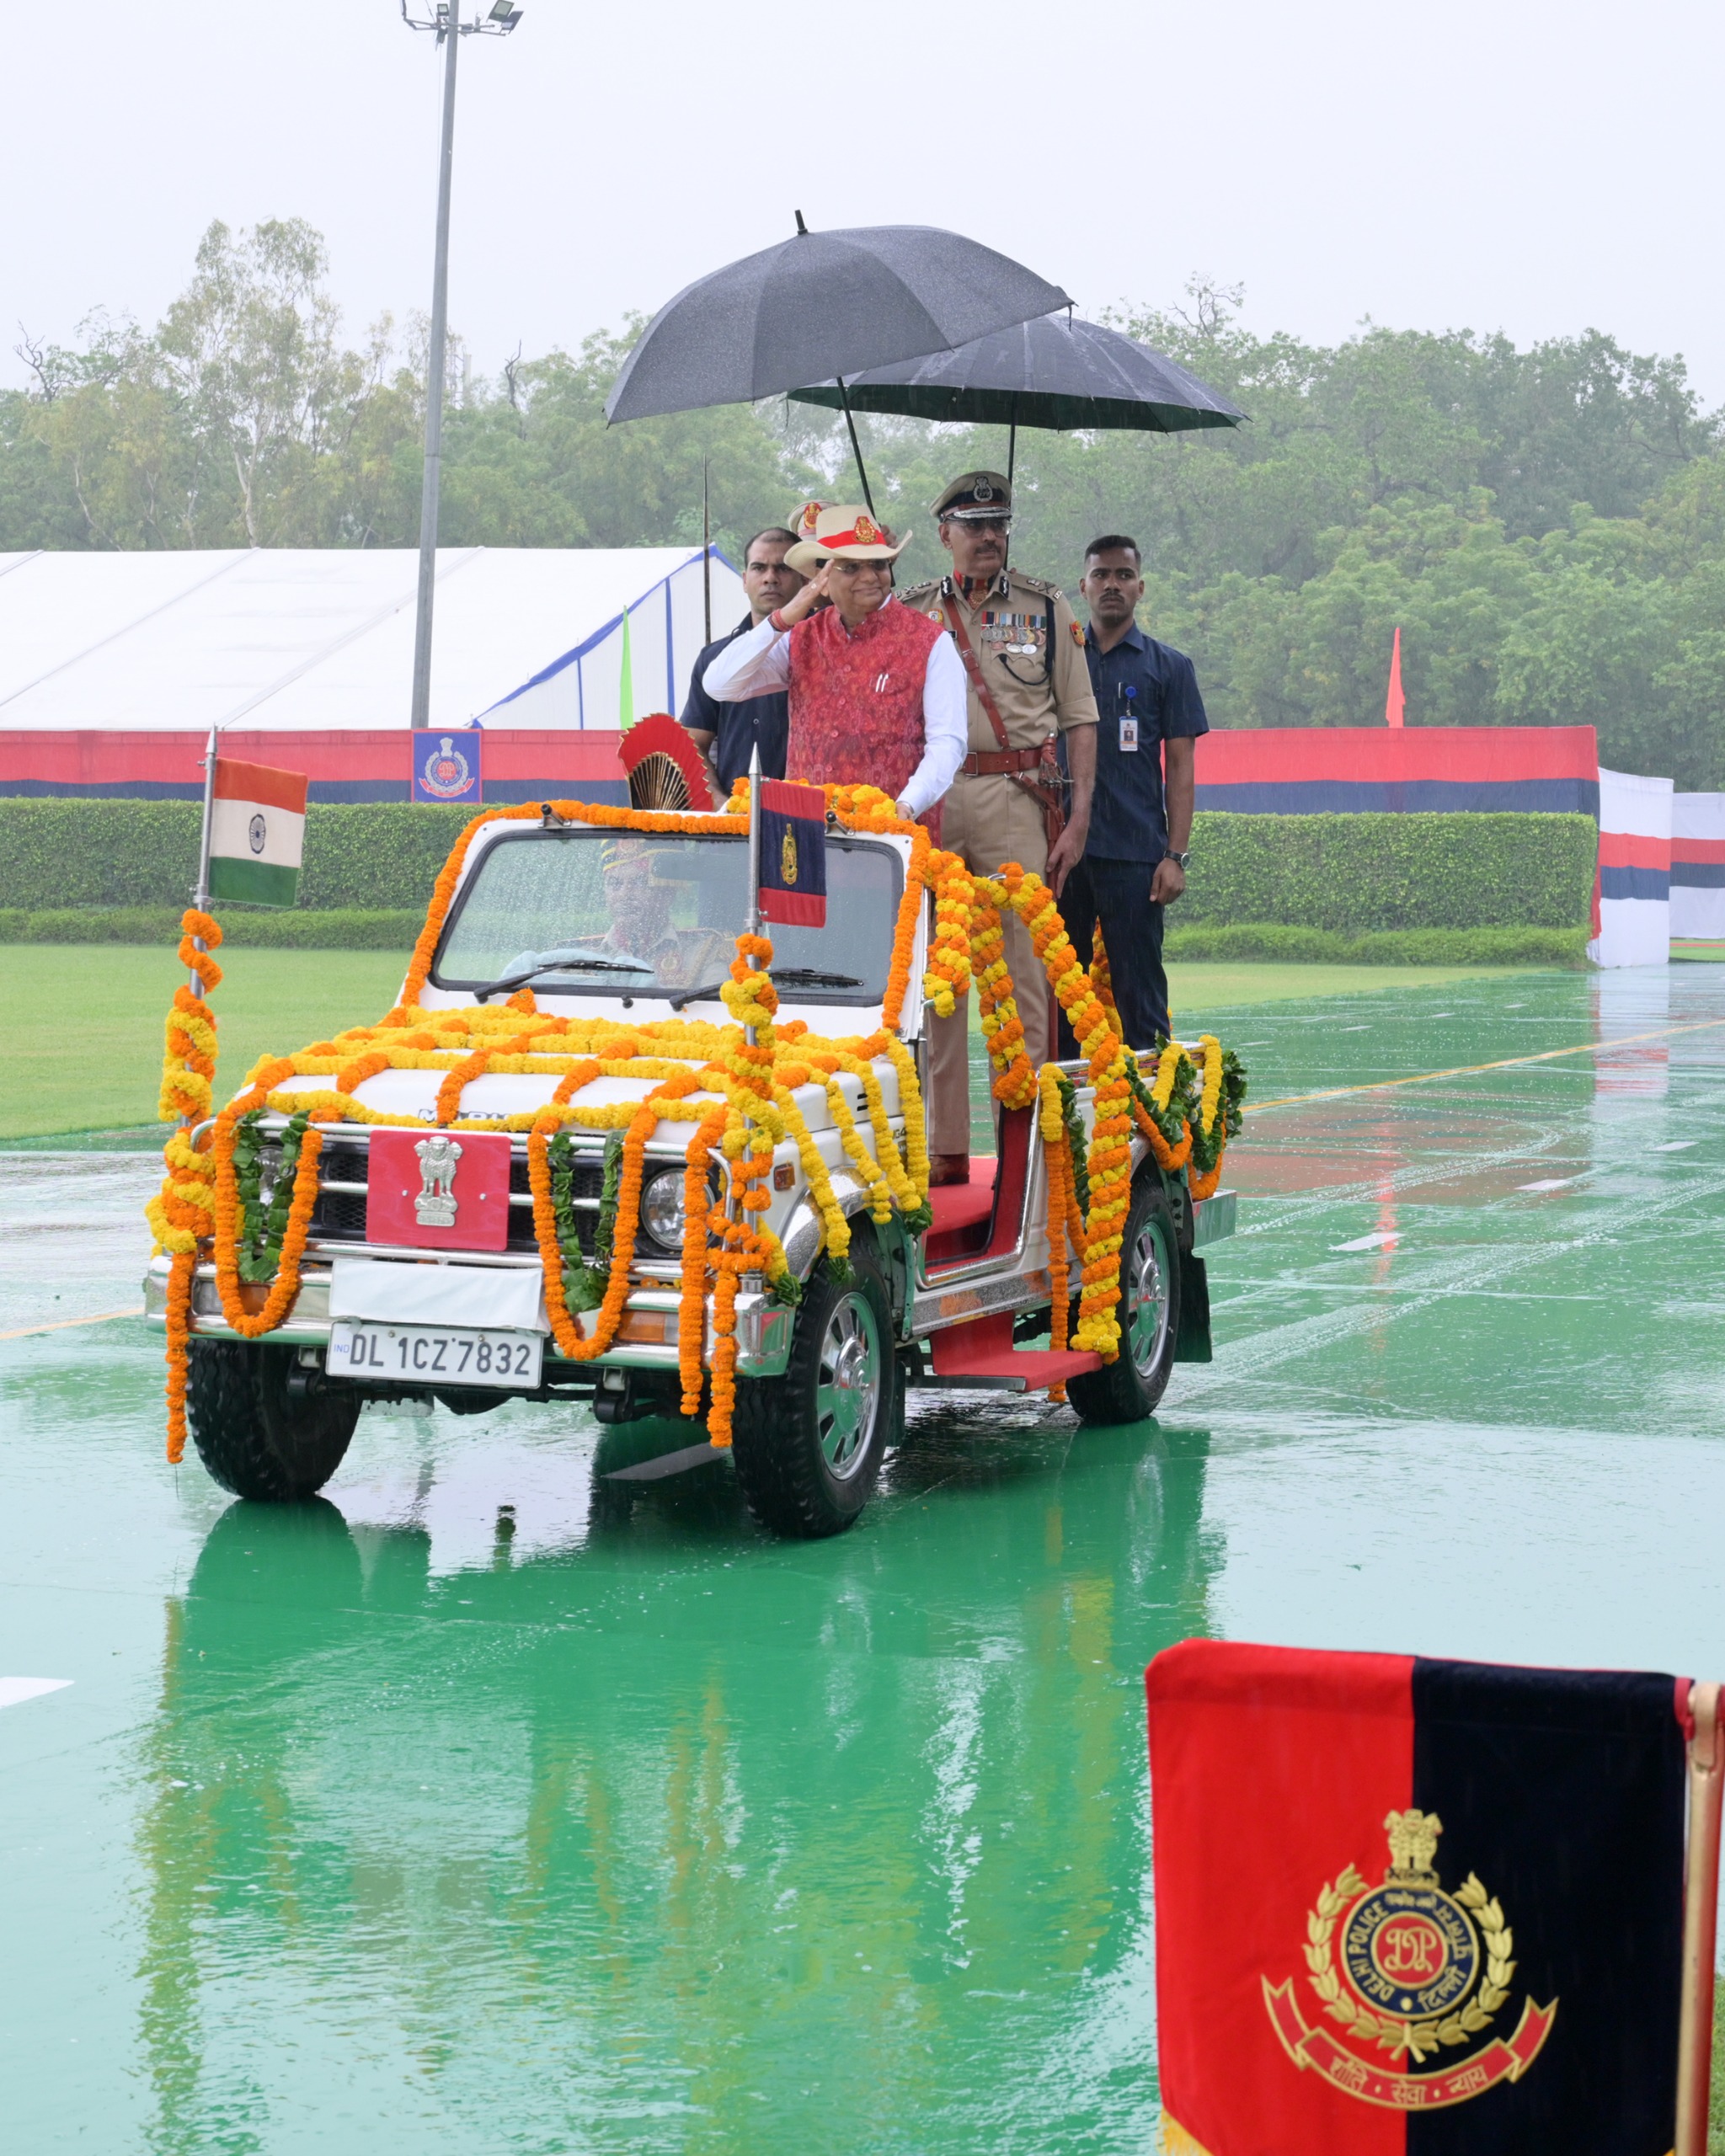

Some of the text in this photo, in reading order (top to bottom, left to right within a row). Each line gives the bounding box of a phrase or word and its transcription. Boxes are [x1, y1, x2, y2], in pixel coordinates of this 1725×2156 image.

[334, 1343, 350, 1354] IND
[1348, 1900, 1396, 2003] DELHI POLICE
[1391, 2079, 1428, 2105] सेवा
